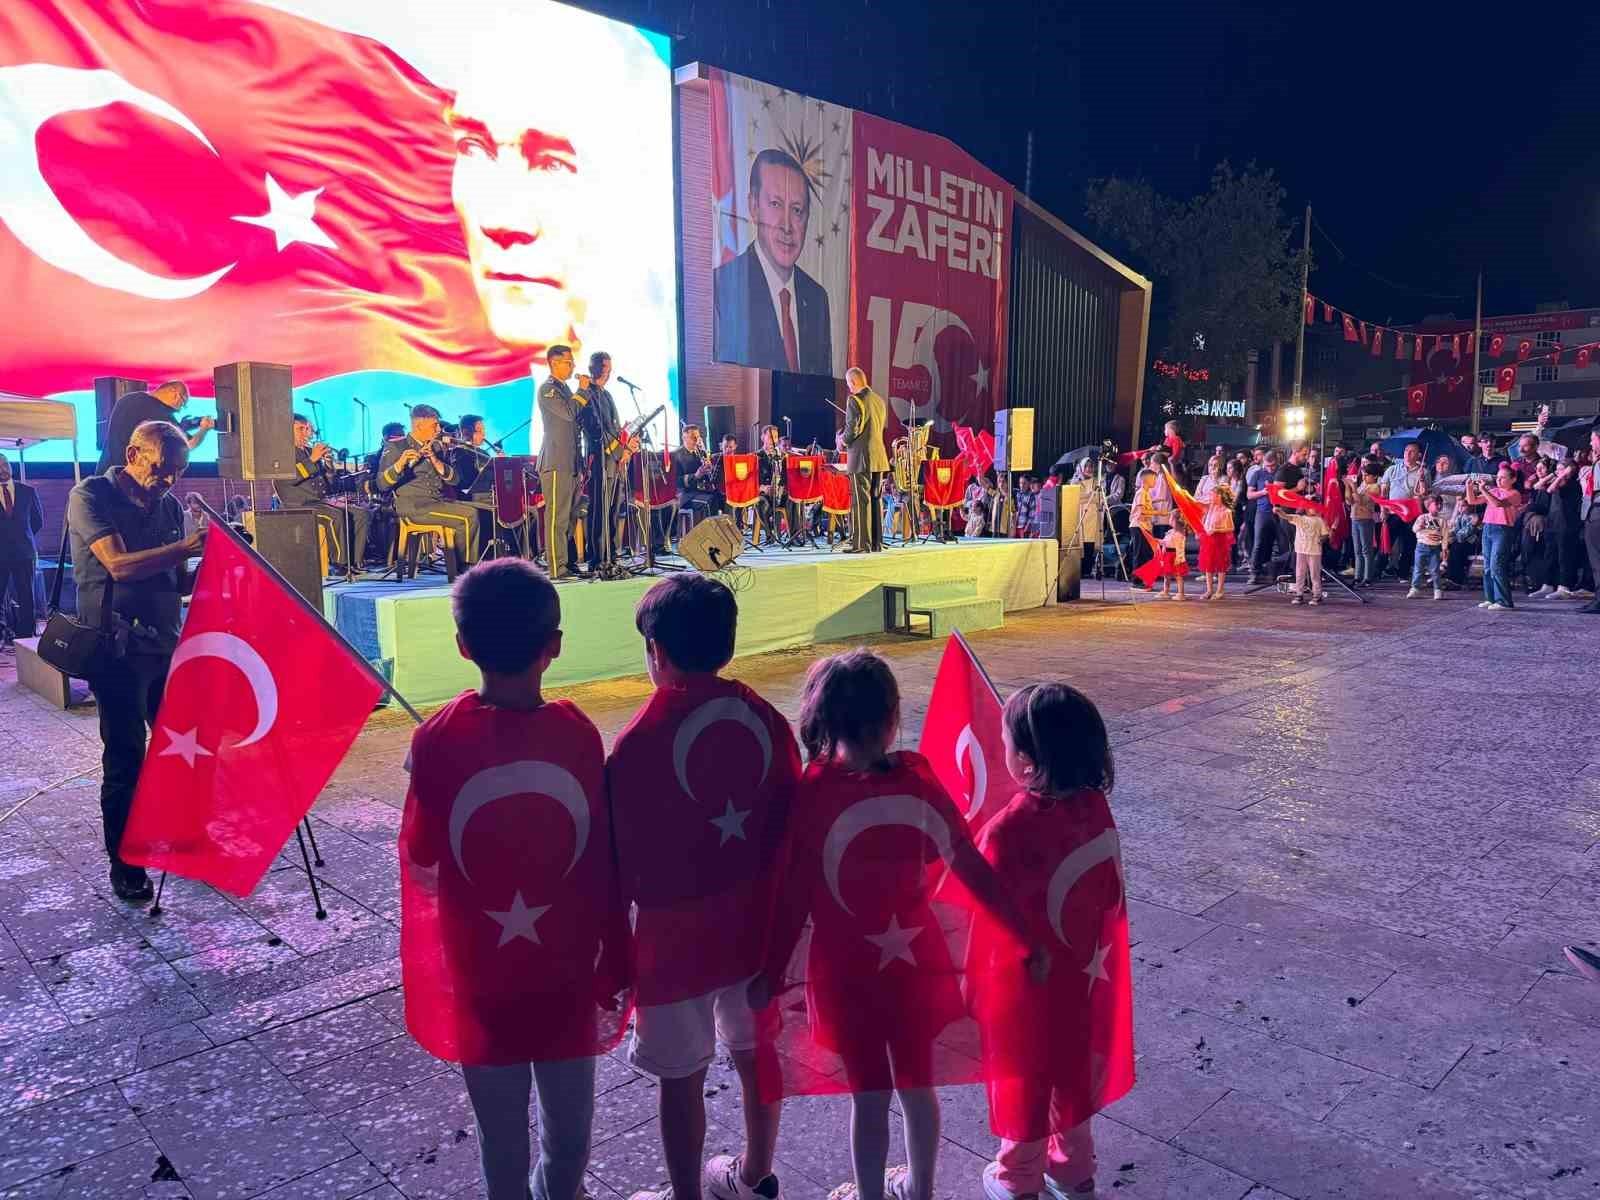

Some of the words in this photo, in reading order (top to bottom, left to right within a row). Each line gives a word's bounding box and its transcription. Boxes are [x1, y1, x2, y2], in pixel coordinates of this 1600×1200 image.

[867, 146, 1003, 229] MİLLETİN
[866, 193, 1003, 280] ZAFERİ
[866, 295, 941, 430] 15
